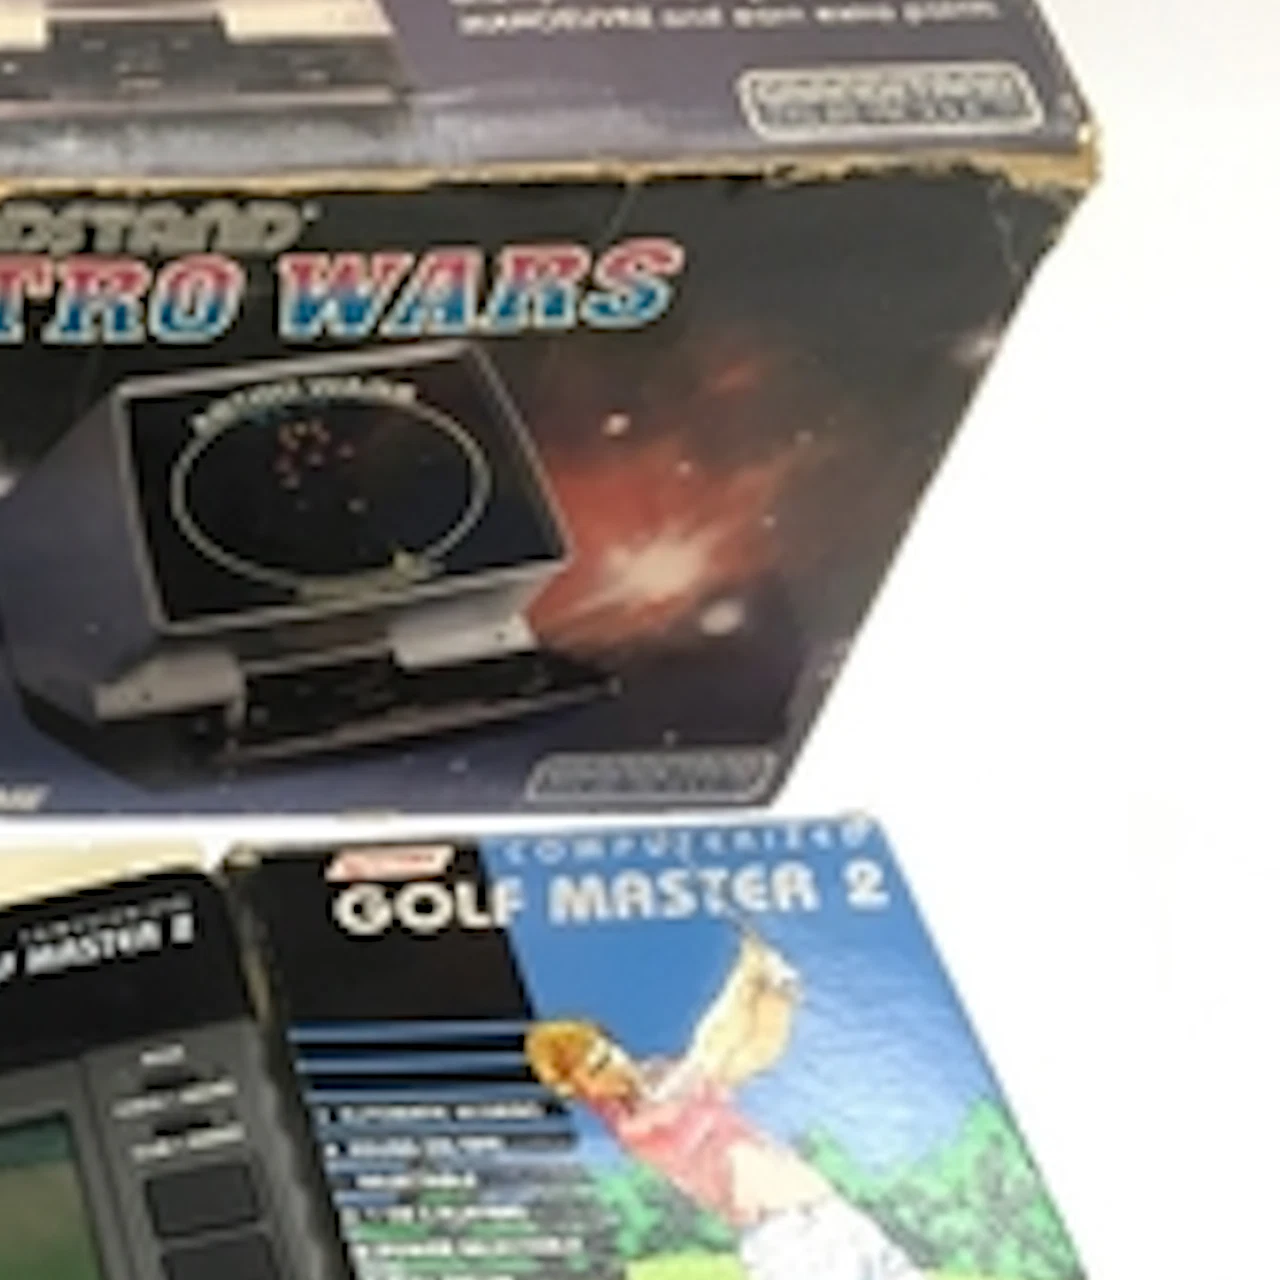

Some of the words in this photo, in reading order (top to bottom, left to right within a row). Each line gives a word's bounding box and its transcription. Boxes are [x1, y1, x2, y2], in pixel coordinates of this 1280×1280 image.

[278, 241, 683, 340] WARS
[333, 876, 526, 935] GOLF
[548, 862, 820, 926] MASTER
[845, 860, 890, 910] 2
[24, 918, 162, 975] MASTER
